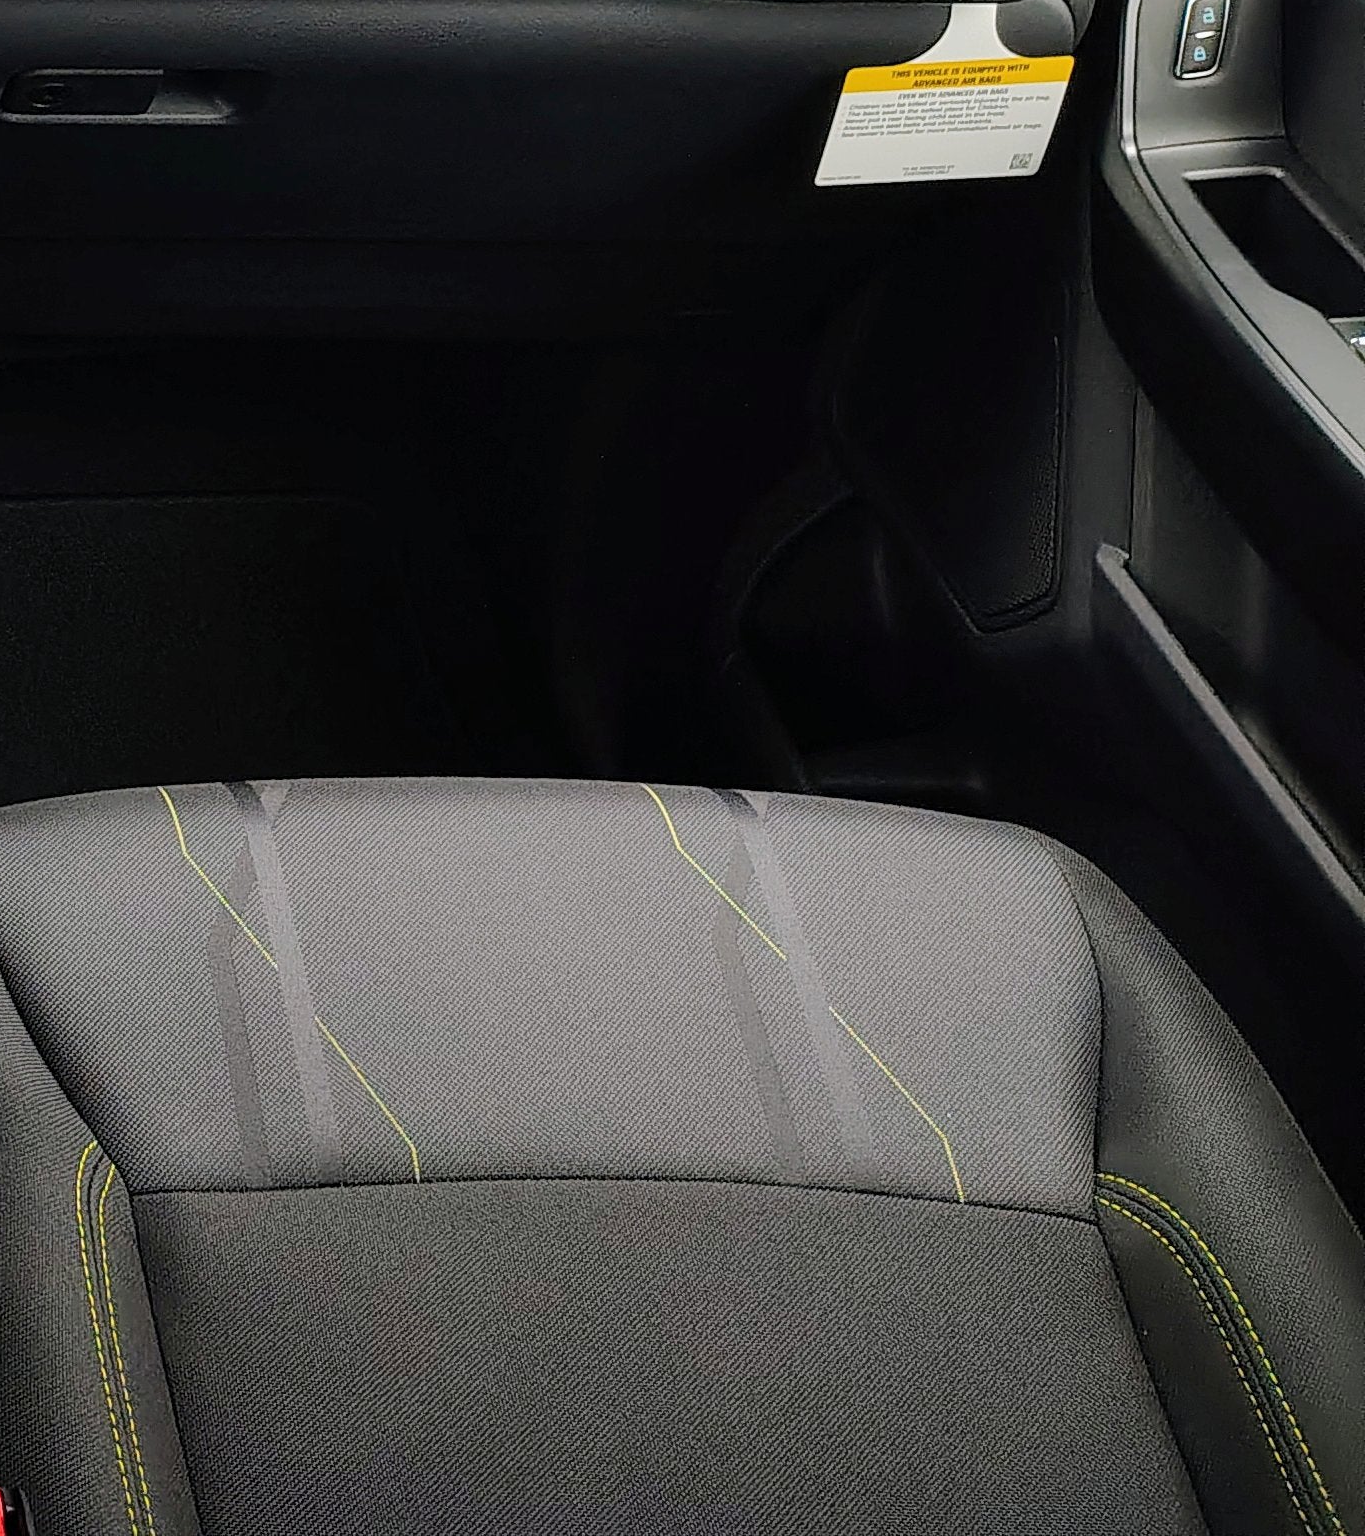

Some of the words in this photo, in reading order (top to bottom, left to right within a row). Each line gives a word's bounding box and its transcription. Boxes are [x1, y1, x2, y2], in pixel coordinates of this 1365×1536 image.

[913, 67, 949, 77] VEHICLE
[911, 77, 960, 88] ADVANCED
[961, 76, 976, 84] AIR
